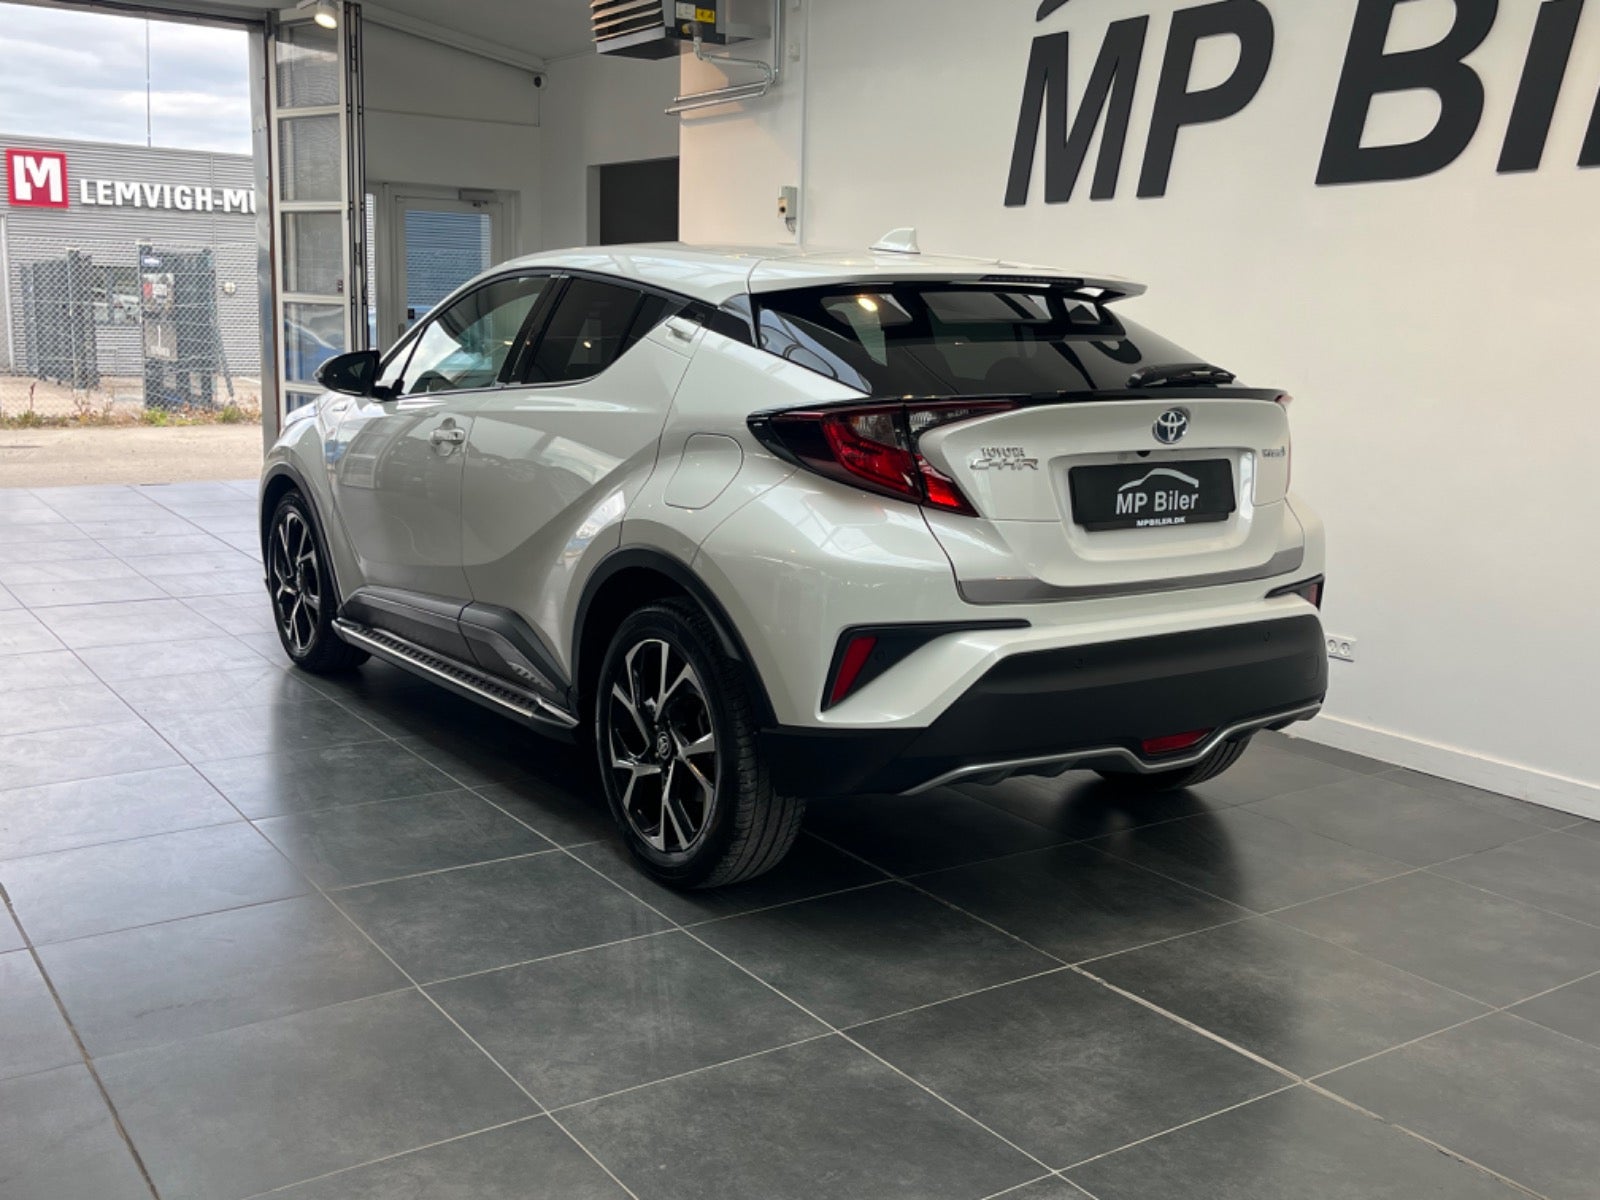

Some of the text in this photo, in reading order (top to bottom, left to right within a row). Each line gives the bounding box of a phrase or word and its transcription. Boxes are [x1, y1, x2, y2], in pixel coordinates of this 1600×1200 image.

[1004, 0, 1274, 207] MP
[1116, 490, 1199, 514] MP Biler
[1136, 516, 1186, 527] MPBILER.DK
